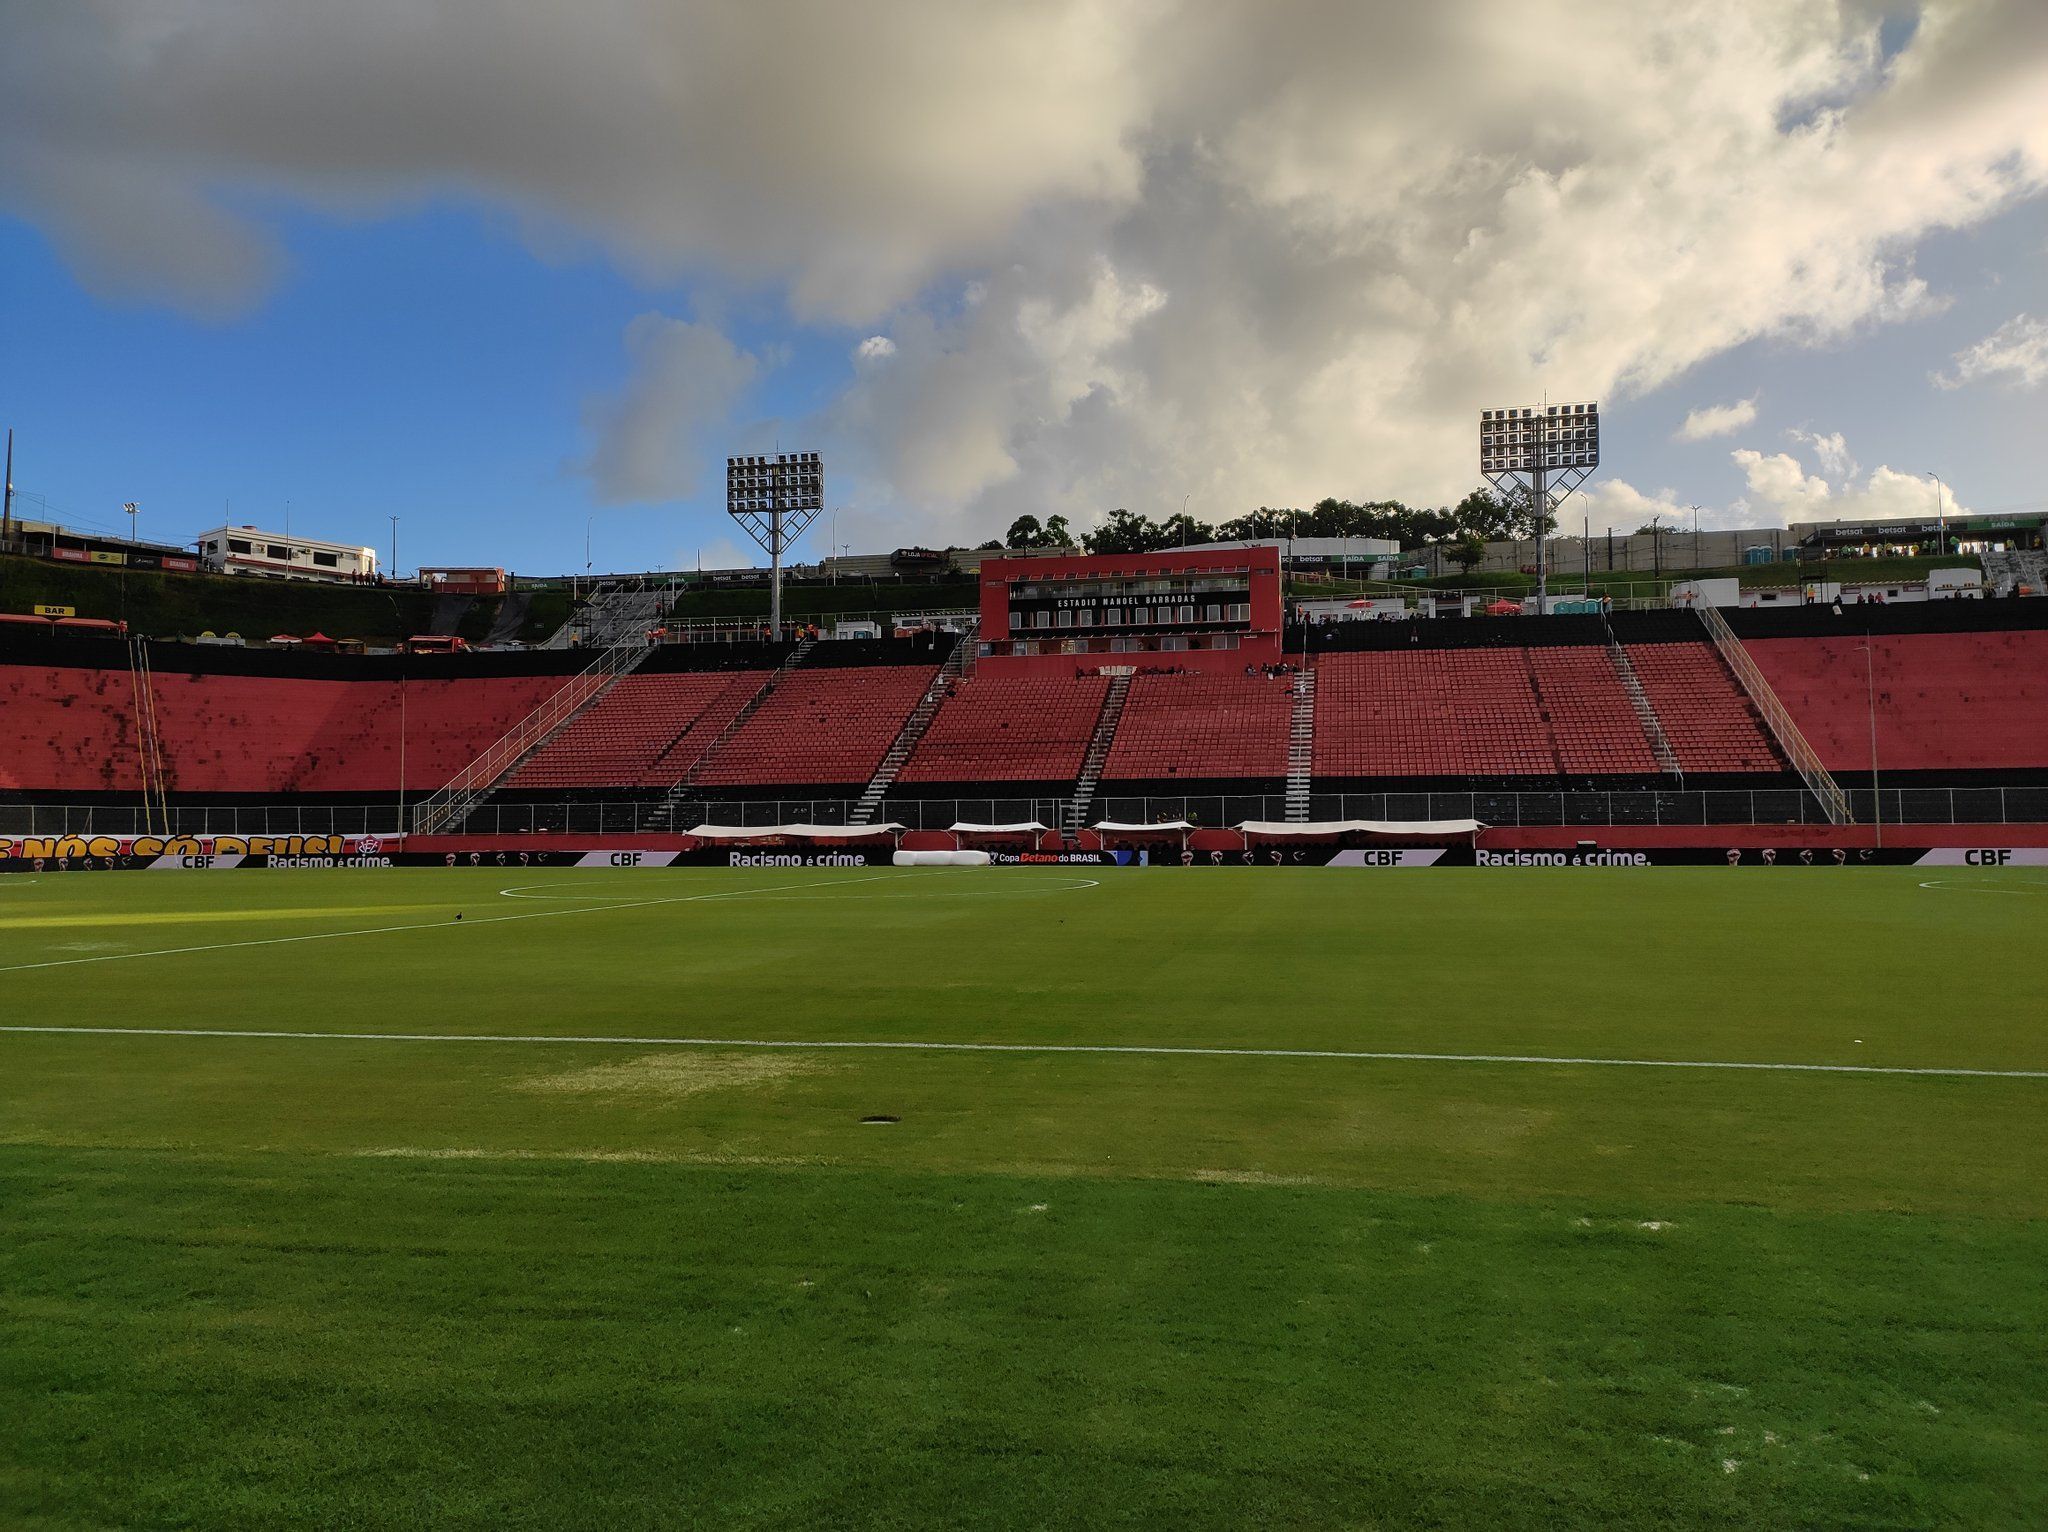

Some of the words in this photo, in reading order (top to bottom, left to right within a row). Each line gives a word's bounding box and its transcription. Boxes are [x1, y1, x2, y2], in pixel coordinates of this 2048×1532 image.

[1835, 528, 1863, 536] betsat
[1878, 526, 1907, 534] betsat
[1103, 597, 1138, 606] MANOEL
[1146, 595, 1195, 604] BARRADAS
[44, 607, 65, 615] BAR
[182, 856, 215, 869] CBF
[267, 854, 333, 868] Racismo
[337, 858, 344, 868] é
[346, 854, 394, 868] crime.
[610, 853, 642, 866] CBF
[729, 851, 801, 867] Racismo
[806, 856, 813, 866] é
[816, 850, 869, 867] crime.
[1000, 853, 1020, 863] Copa
[1021, 853, 1058, 862] Betano
[1058, 854, 1069, 862] do
[1070, 854, 1101, 862] BRASIL
[1364, 850, 1403, 866] CBF
[1475, 849, 1566, 866] Racismo
[1572, 853, 1581, 866] é
[1585, 849, 1652, 866] crime.
[1965, 849, 2011, 865] CBF
